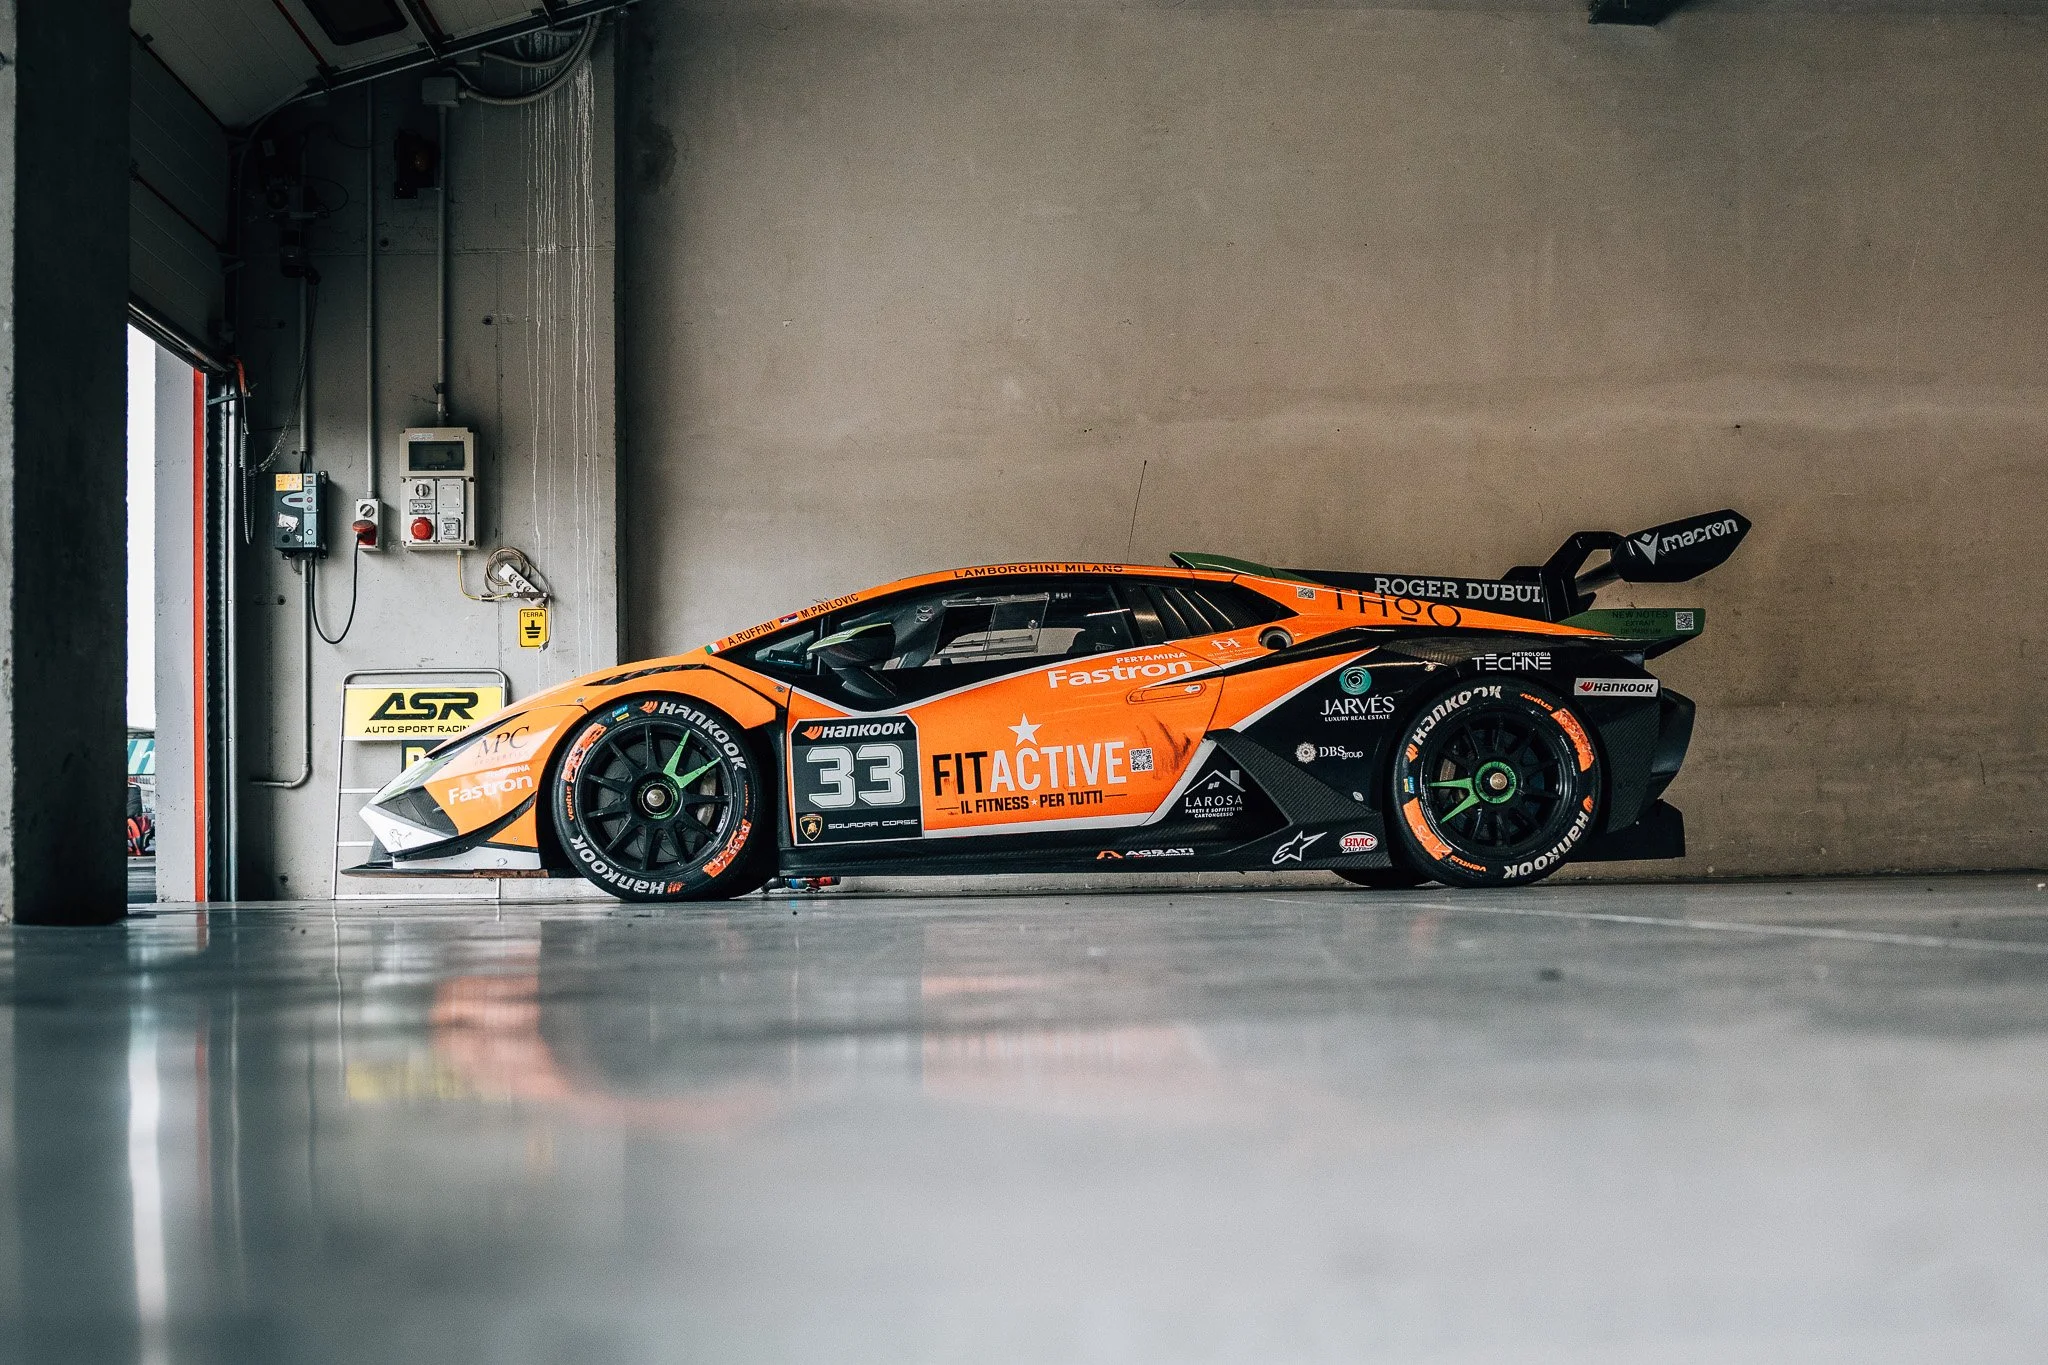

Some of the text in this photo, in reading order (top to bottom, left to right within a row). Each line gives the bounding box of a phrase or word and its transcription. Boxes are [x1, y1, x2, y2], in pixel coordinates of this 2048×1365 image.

[1662, 518, 1739, 552] macron
[1065, 564, 1123, 573] MILANO
[1374, 577, 1460, 599] ROGER
[800, 593, 859, 618] M.PAVLOVIC
[1636, 610, 1669, 618] NOTES
[727, 621, 776, 646] A.RUFFINI
[1115, 652, 1187, 663] PERTAMINA
[1047, 661, 1192, 689] Fastron
[369, 692, 478, 720] ASR
[1320, 694, 1395, 715] JARVÉS
[806, 743, 906, 809] 33
[448, 774, 533, 805] Fastron
[961, 789, 1103, 814] IL FITNESS PER TUTTI
[1185, 795, 1243, 807] LAROSA
[828, 819, 918, 830] SQUADRA CORSE
[1194, 811, 1234, 819] CARTONGESSO
[1344, 837, 1374, 847] BMC
